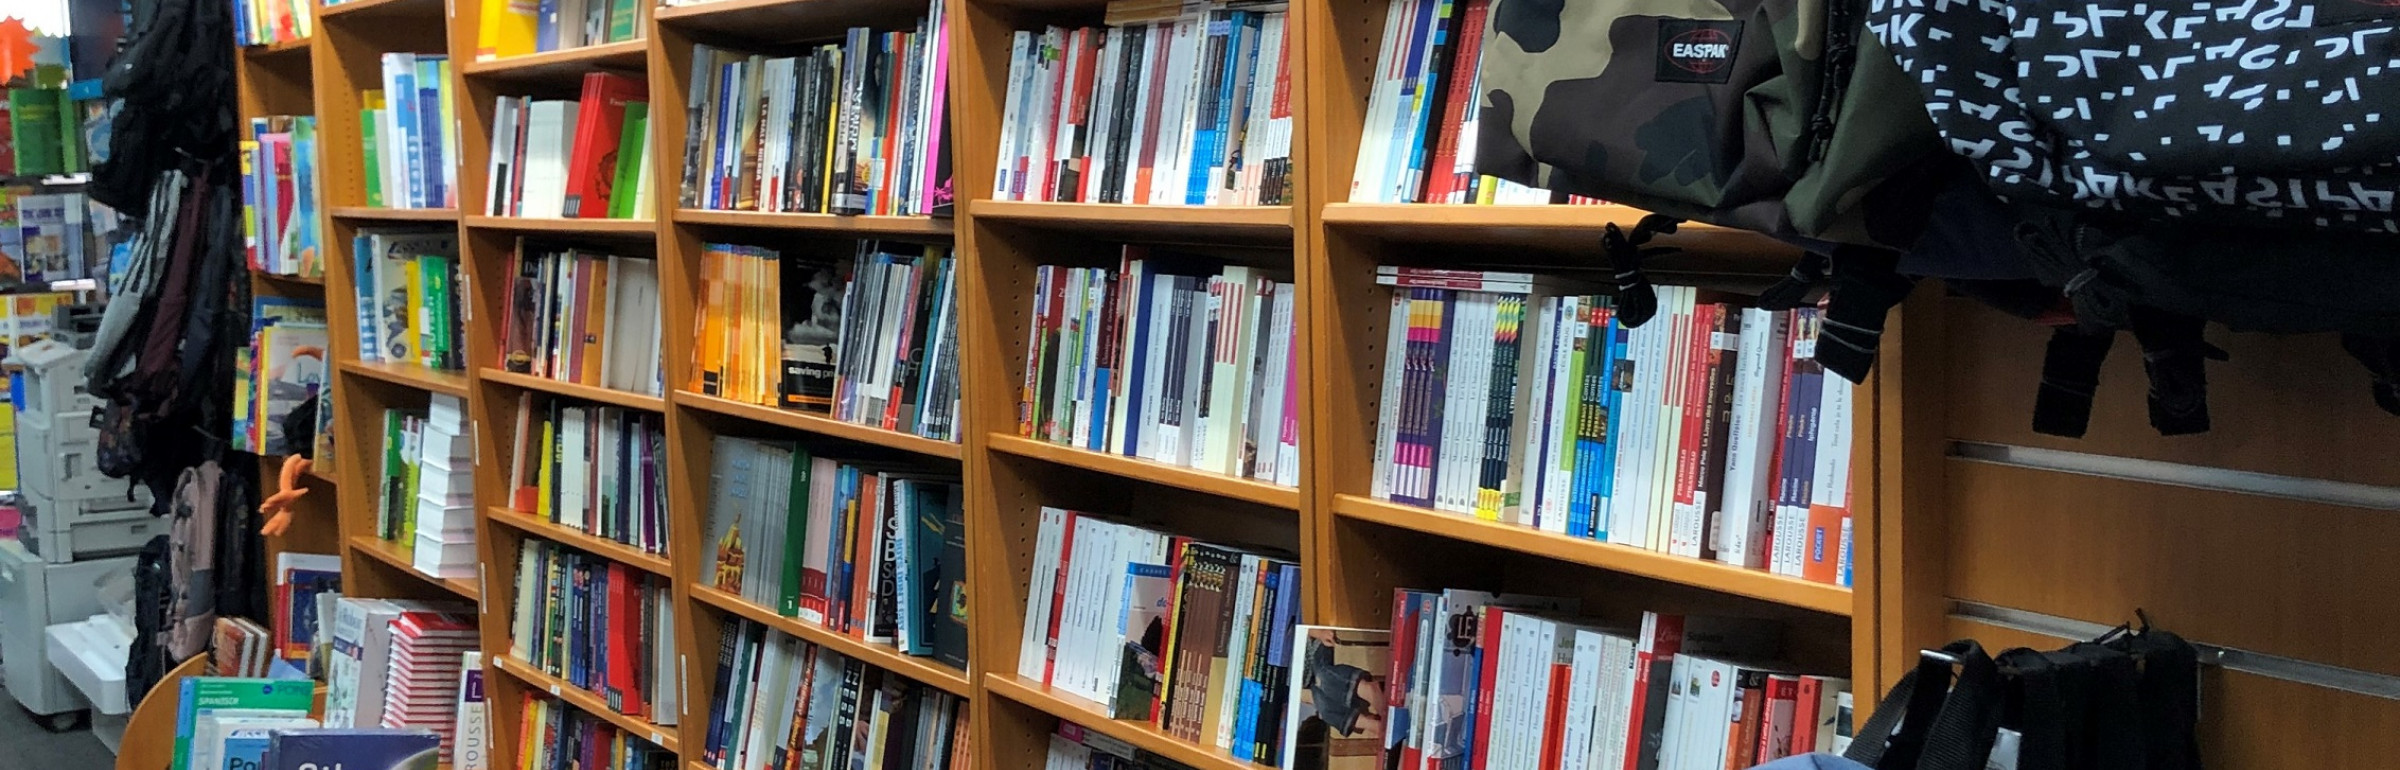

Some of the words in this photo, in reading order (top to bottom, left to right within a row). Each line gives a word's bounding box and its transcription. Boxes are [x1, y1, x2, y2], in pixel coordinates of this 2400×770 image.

[788, 367, 821, 378] saving
[1581, 375, 1590, 402] Contes
[1589, 375, 1598, 402] Contes
[1677, 449, 1687, 496] PIRANDELLO
[1686, 450, 1696, 498] PIRANDELLO
[1729, 453, 1737, 471] Yann
[1697, 468, 1707, 488] Marco
[1779, 477, 1788, 502] Racine
[1790, 477, 1800, 502] Racine
[1692, 500, 1702, 547] LAROUSSE
[1772, 515, 1784, 564] LAROUSSE
[1783, 515, 1795, 564] LAROUSSE
[1794, 517, 1806, 567] LAROUSSE
[1814, 528, 1823, 561] POCKET
[1837, 527, 1849, 577] LAROUSSE
[1457, 616, 1472, 639] LE
